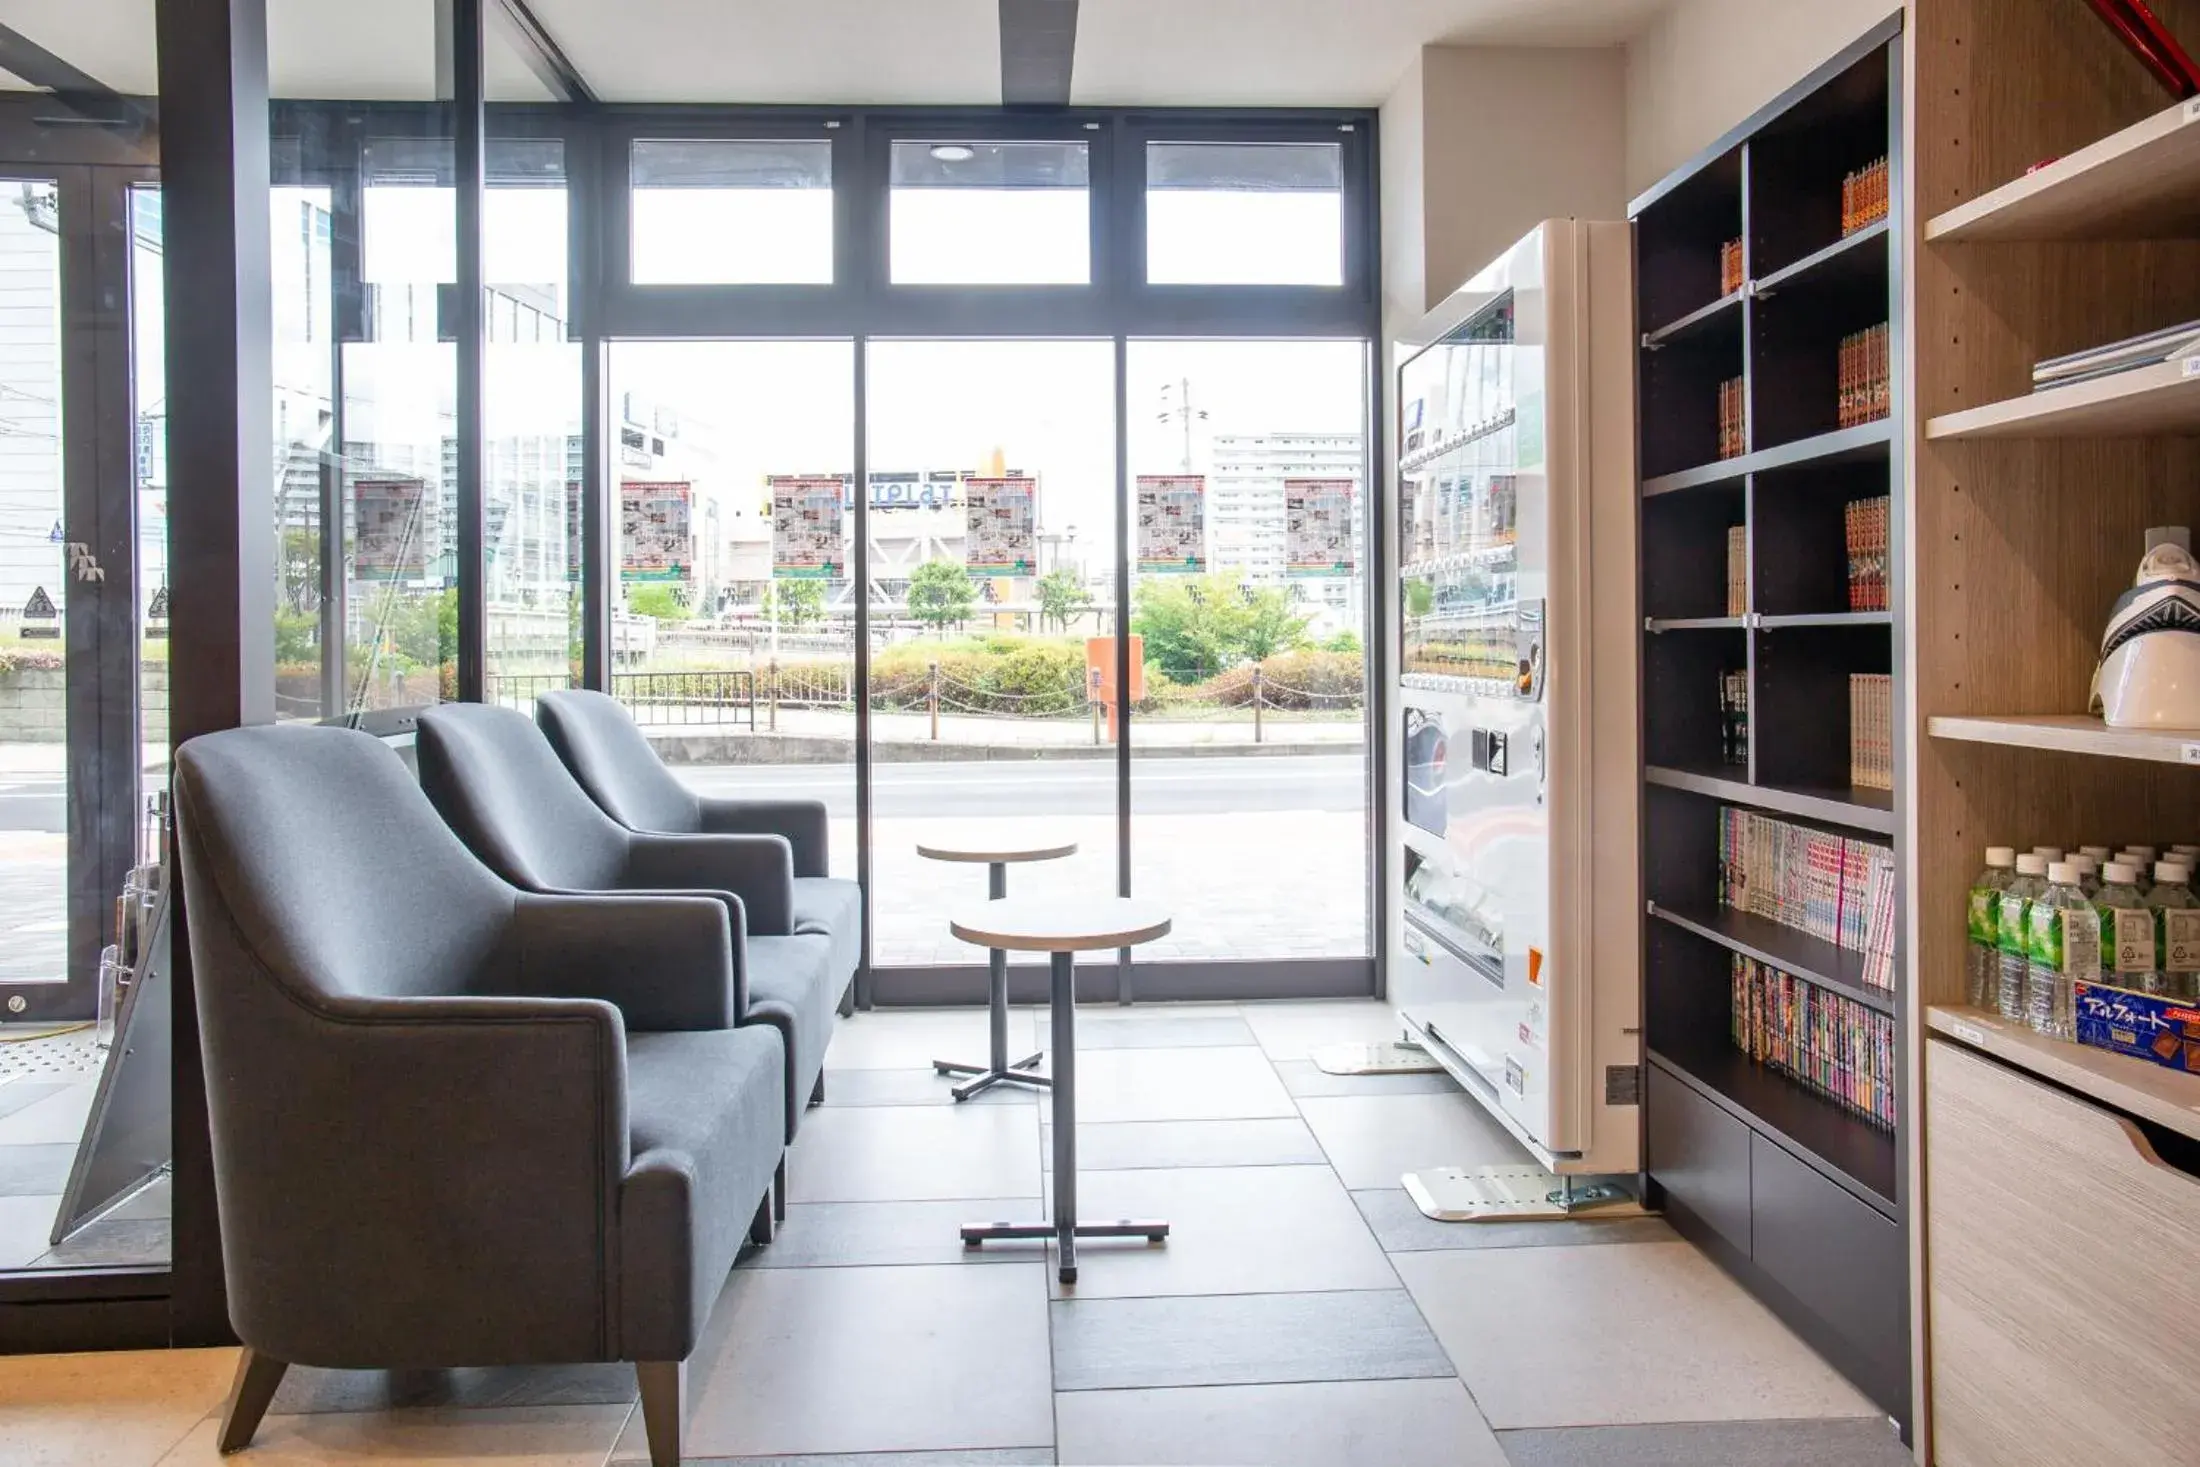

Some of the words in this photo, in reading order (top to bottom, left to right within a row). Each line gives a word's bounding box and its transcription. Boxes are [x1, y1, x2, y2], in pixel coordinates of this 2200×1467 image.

[2083, 997, 2170, 1030] アルフォート
